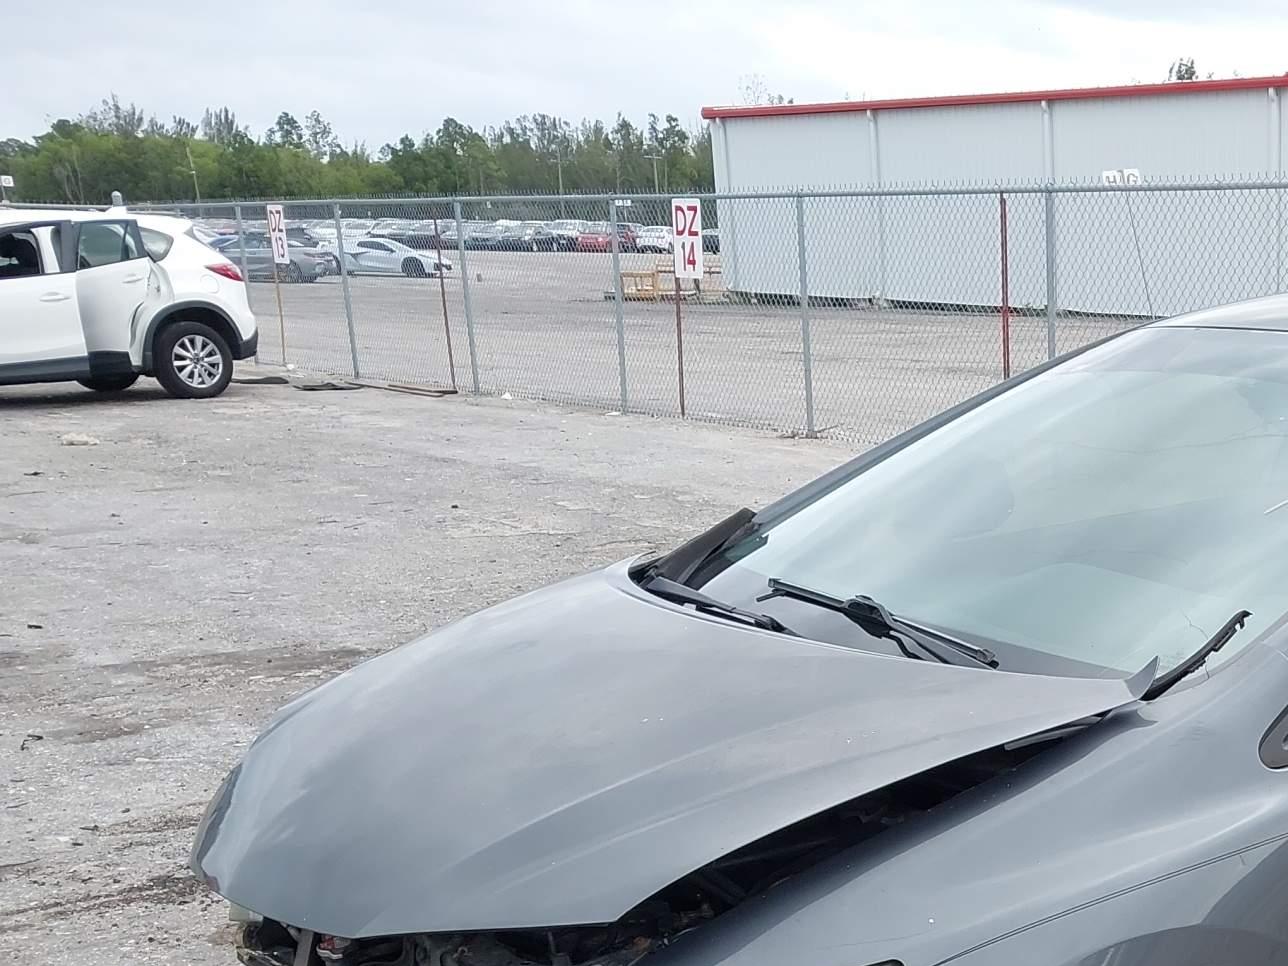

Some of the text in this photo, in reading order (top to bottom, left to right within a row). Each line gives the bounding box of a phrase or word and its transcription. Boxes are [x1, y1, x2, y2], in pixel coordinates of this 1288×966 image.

[269, 210, 284, 232] DZ
[674, 205, 699, 236] DZ
[275, 236, 285, 258] 13
[681, 241, 697, 271] 14
